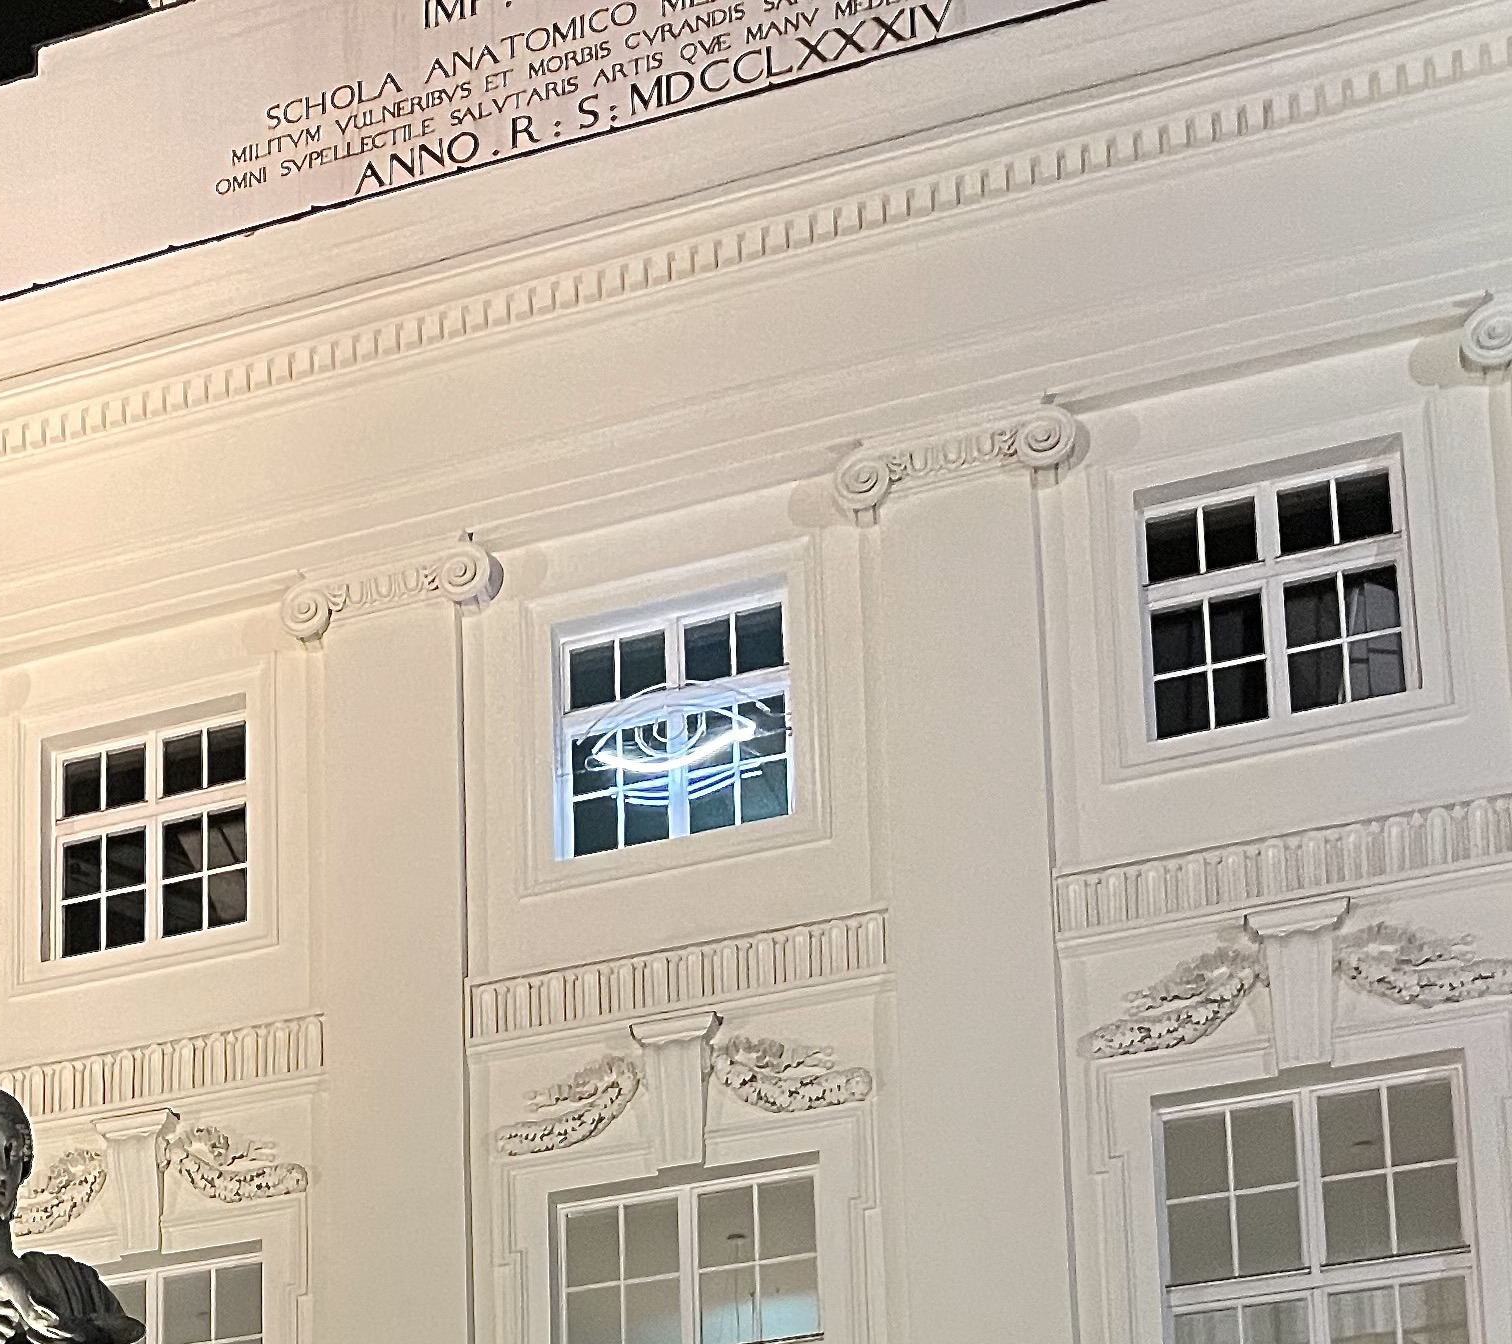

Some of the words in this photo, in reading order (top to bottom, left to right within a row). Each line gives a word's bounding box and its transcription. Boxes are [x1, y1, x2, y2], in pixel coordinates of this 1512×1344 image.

[215, 166, 267, 196] OMNI
[280, 116, 436, 177] SVPELLECTILE
[450, 75, 579, 127] SALVTARIS
[592, 51, 664, 88] ARTIS
[745, 7, 820, 45] MANV
[266, 72, 403, 131] SCHOLA
[424, 1, 637, 84] ANATOMICO
[484, 68, 514, 93] ET
[528, 40, 612, 79] MORBIS
[624, 1, 746, 50] CVRANDIS
